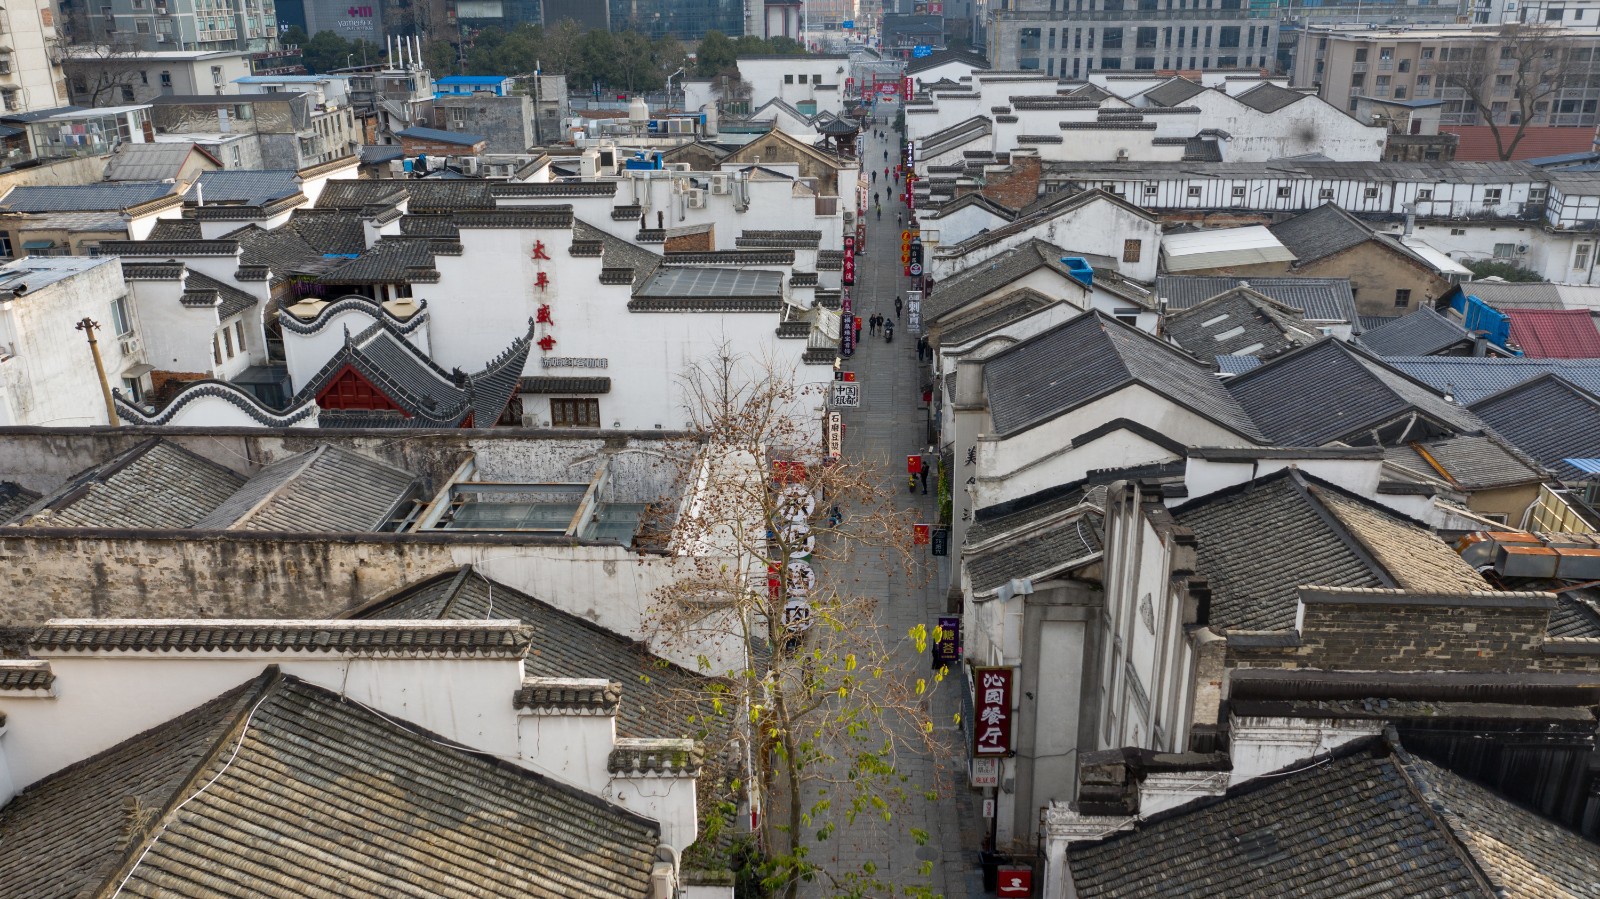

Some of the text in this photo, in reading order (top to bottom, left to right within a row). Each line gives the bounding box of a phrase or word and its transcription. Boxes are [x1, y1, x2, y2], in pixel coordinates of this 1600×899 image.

[531, 240, 557, 351] 太平盛世
[835, 385, 856, 396] 中国
[835, 396, 856, 405] 银都
[979, 673, 1006, 745] 沁园餐厅
